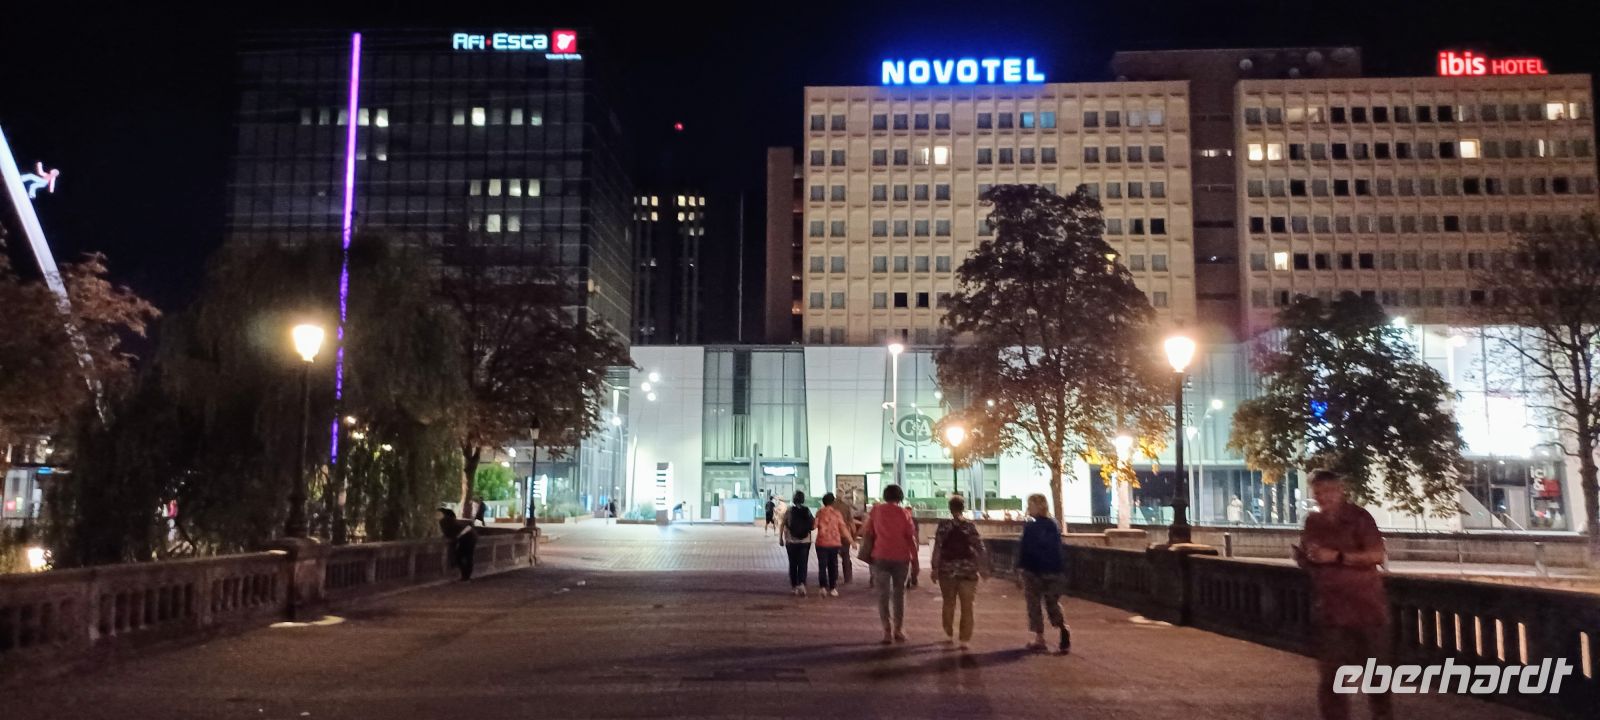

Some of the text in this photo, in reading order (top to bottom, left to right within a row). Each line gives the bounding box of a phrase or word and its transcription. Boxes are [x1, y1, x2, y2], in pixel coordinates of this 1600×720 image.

[882, 58, 1045, 84] NOVOTEL
[1439, 51, 1547, 75] ibis HOTEL
[900, 419, 932, 436] C&A
